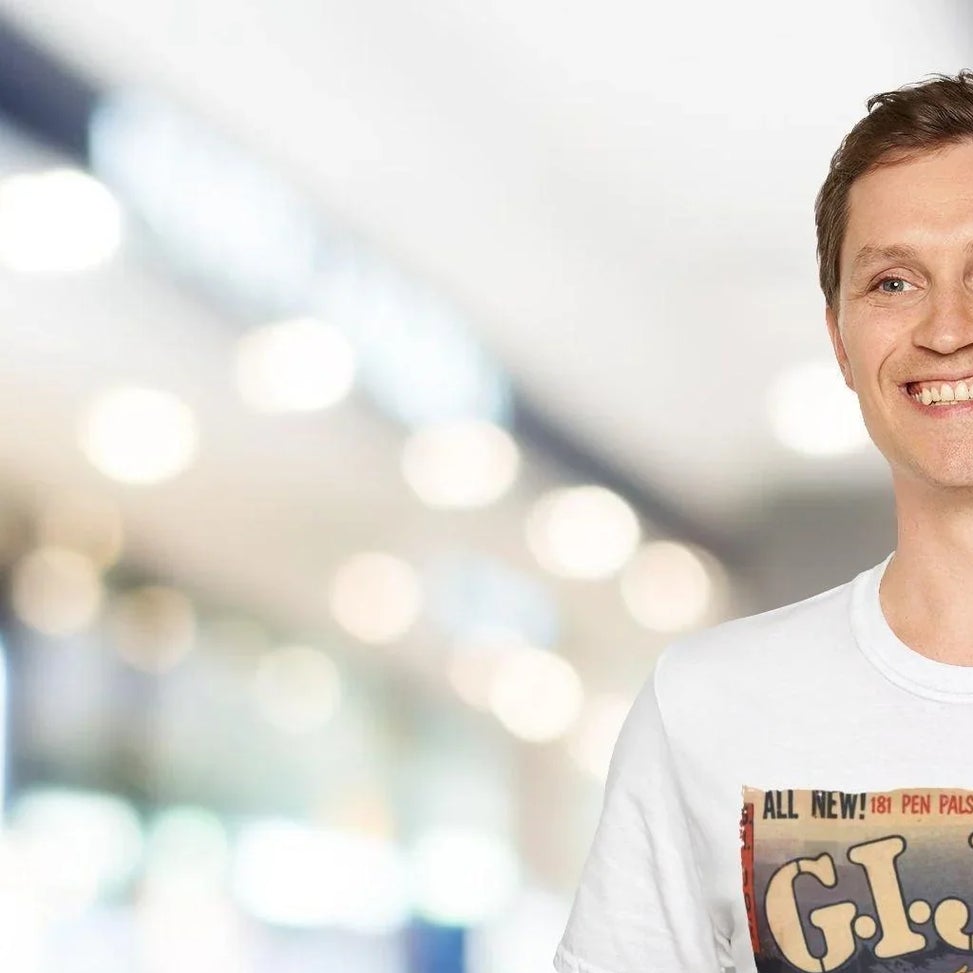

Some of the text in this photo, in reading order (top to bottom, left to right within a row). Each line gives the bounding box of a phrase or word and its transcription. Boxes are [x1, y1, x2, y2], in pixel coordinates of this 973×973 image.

[762, 789, 799, 819] ALL
[811, 789, 866, 820] NEW!
[871, 796, 892, 814] 181
[901, 795, 930, 814] PEN
